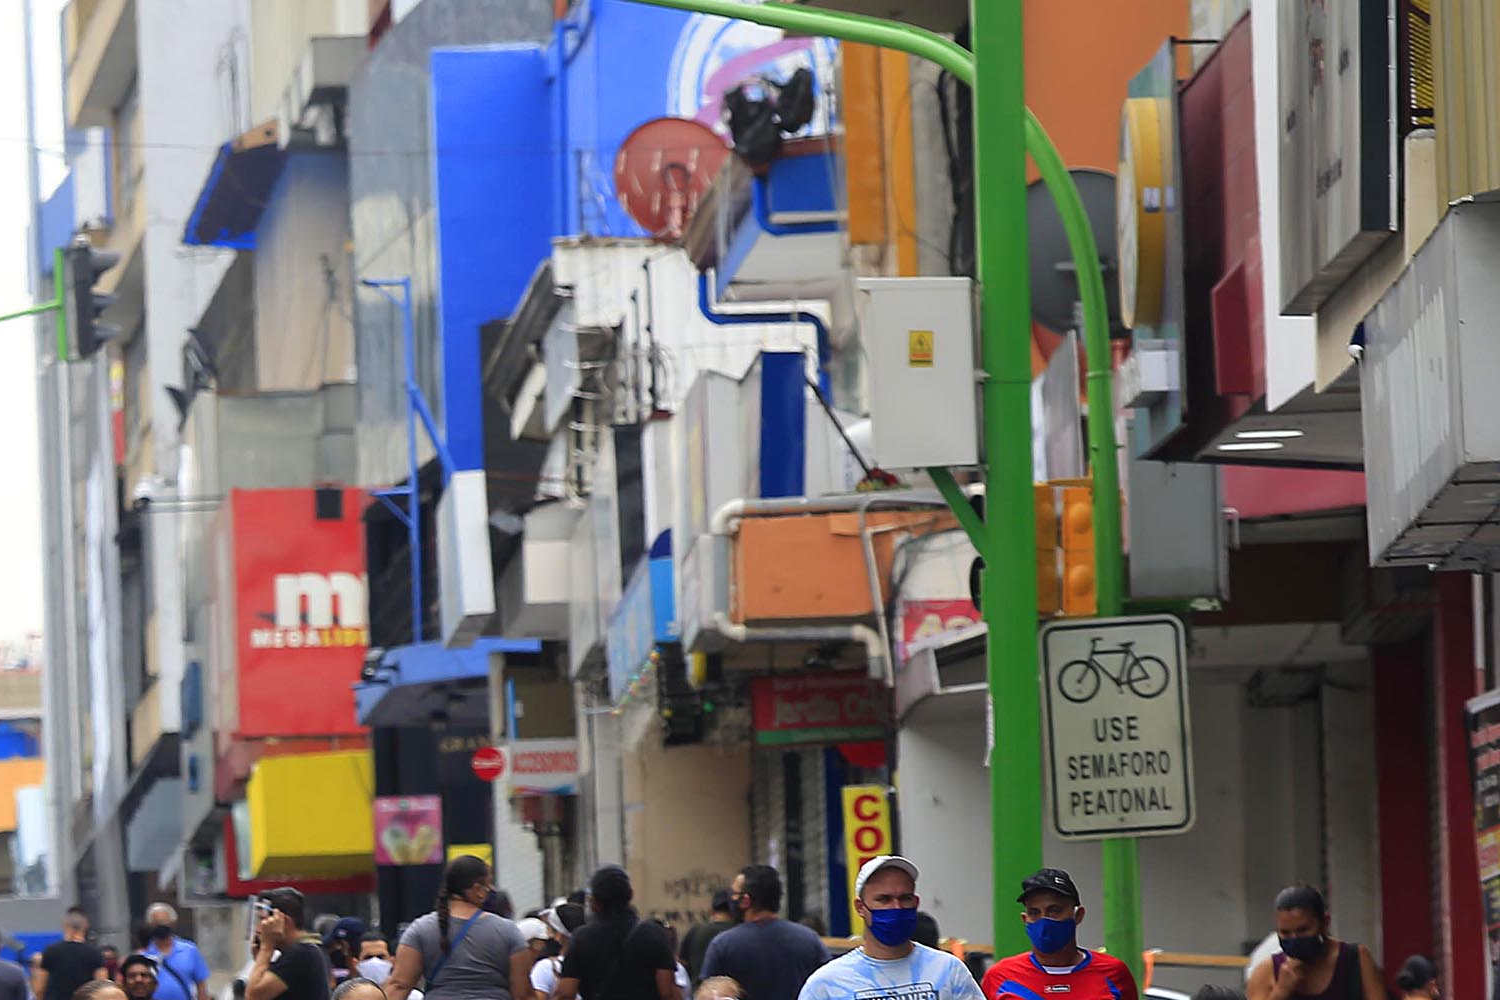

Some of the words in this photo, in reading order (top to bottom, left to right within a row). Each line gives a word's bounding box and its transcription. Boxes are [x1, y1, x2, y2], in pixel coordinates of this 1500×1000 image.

[1093, 716, 1139, 742] USE
[1068, 750, 1171, 780] SEMAFORO
[1070, 786, 1173, 816] PEATONAL
[853, 794, 885, 868] CO
